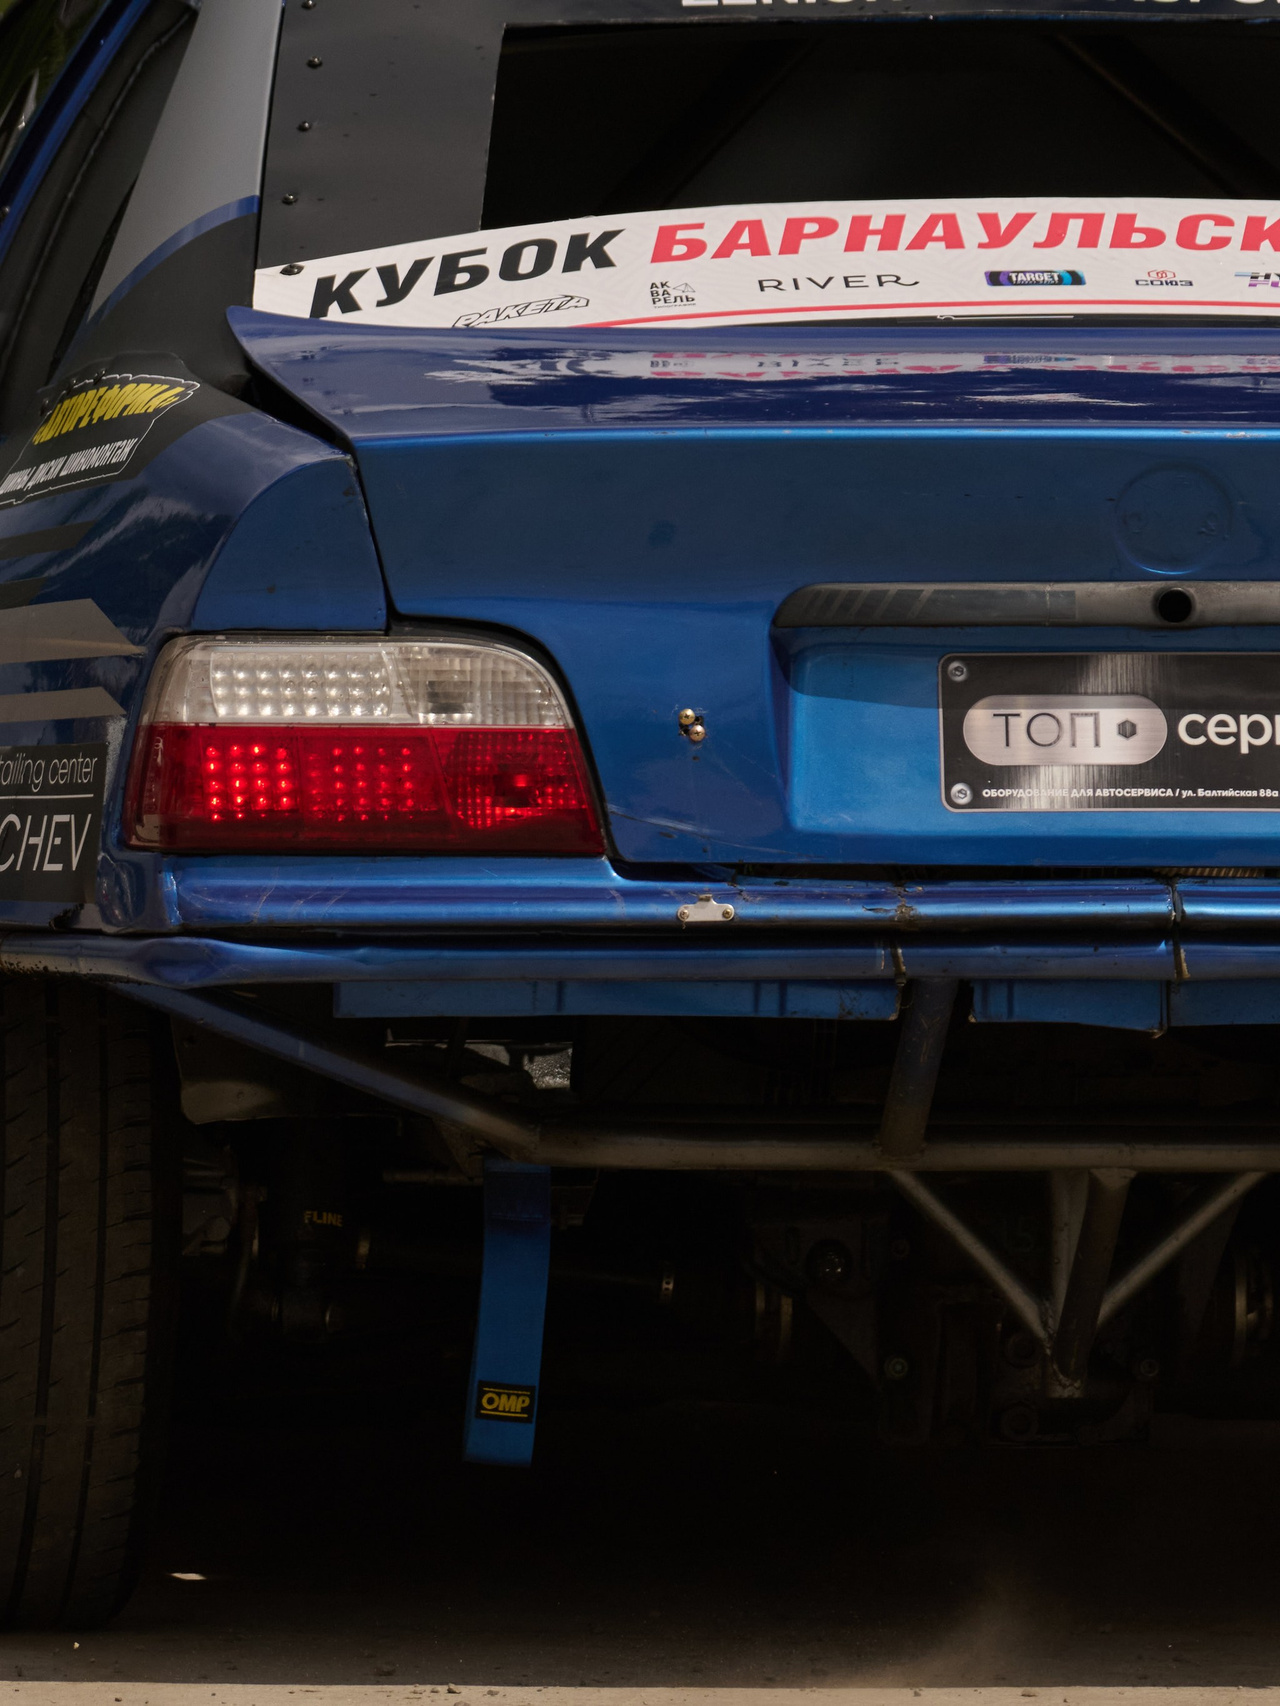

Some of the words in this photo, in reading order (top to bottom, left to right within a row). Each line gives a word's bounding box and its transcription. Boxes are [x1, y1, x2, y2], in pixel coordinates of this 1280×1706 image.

[310, 228, 625, 319] КУБОК
[649, 212, 1280, 264] БАРНАУЛЬСК
[758, 273, 920, 292] RIVER
[1009, 272, 1060, 282] TARGET
[1134, 279, 1194, 287] СОЮЗ
[992, 711, 1101, 748] ТОП
[1178, 713, 1280, 754] сер
[48, 752, 98, 785] center
[982, 788, 1069, 798] ОБОРУДОВАНИЕ
[1071, 788, 1094, 799] ДЛЯ
[1095, 788, 1174, 798] АВТОСЕРВИСА
[1181, 789, 1197, 799] ул.
[1197, 788, 1258, 798] Балтийская
[481, 1392, 531, 1413] OMP
